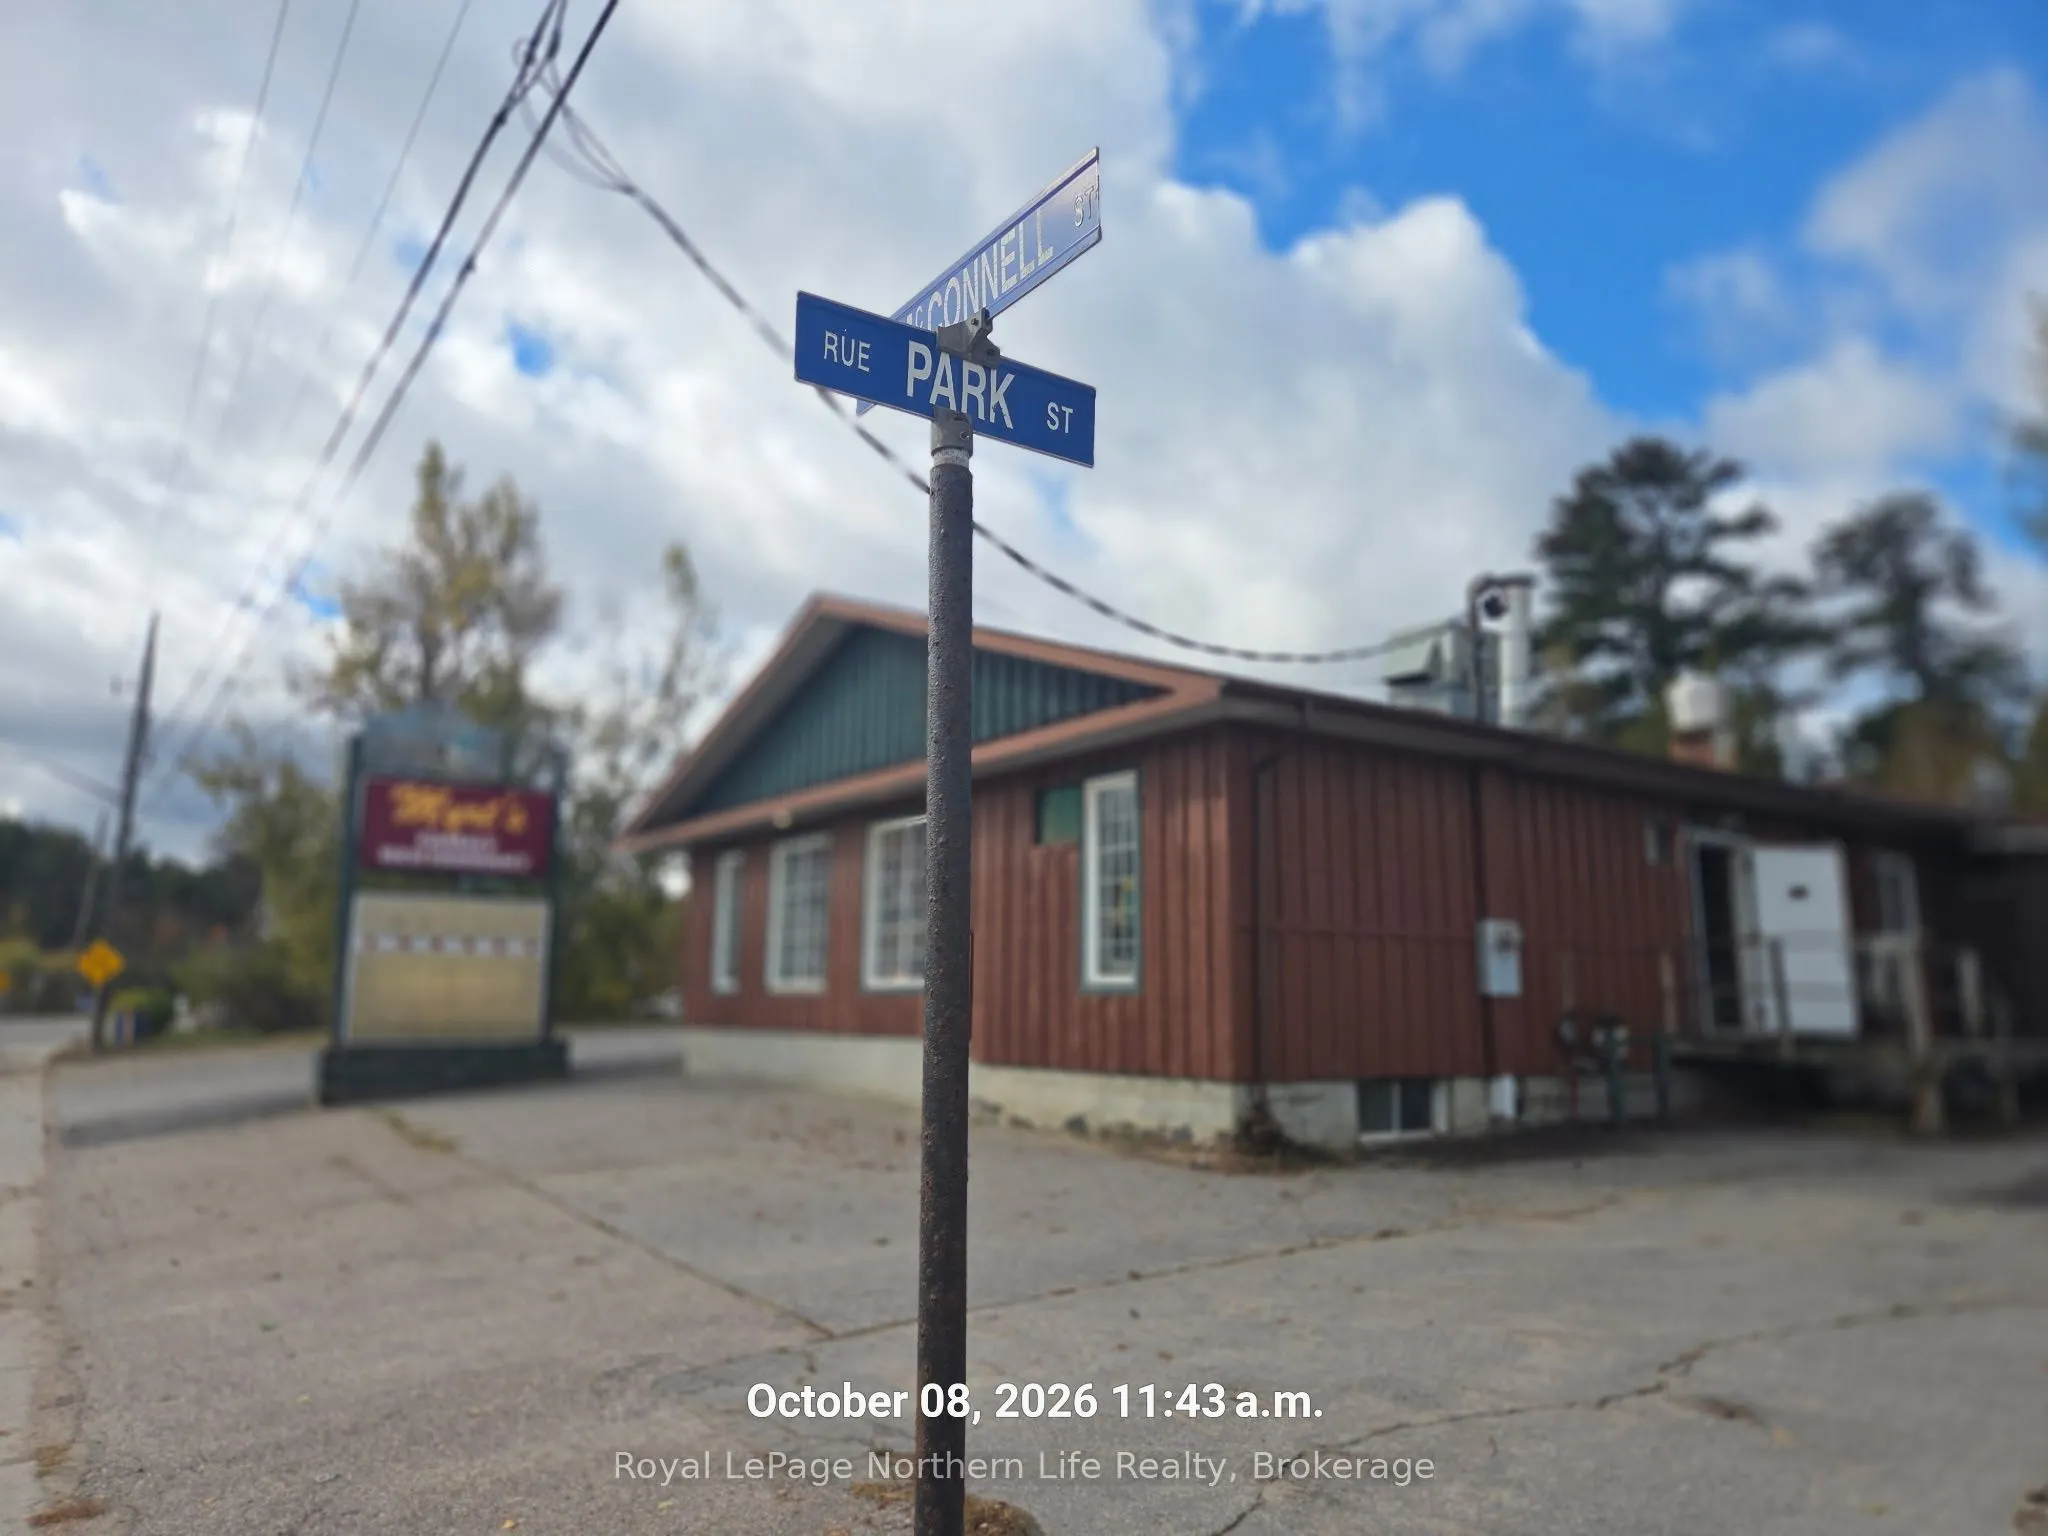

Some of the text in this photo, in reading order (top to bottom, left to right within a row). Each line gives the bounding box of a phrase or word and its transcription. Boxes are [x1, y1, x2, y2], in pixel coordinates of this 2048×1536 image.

[1074, 185, 1097, 228] ST
[823, 330, 1074, 434] RUE PARK ST
